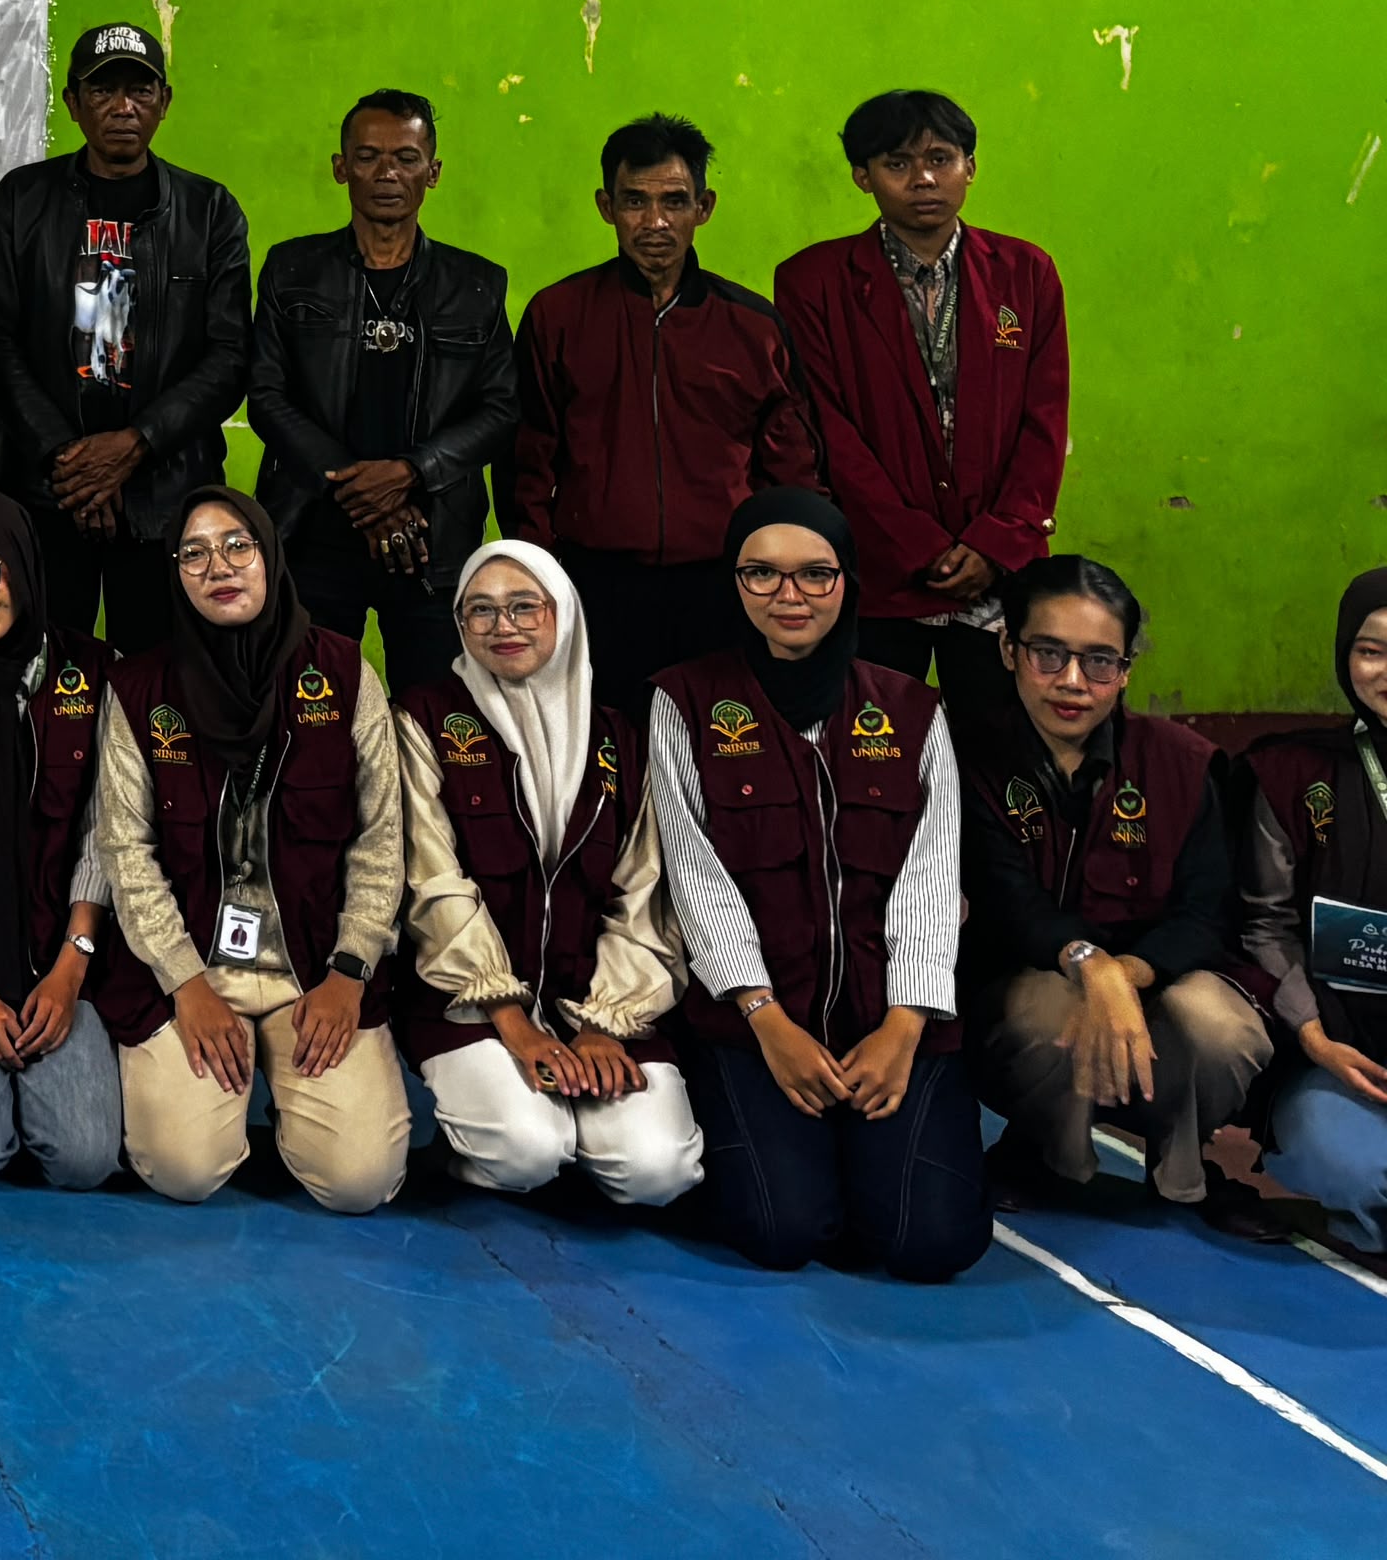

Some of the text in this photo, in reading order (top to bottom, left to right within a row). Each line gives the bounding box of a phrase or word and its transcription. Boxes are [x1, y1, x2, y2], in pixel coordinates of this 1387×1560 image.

[54, 705, 95, 716] UNINUS
[297, 710, 340, 724] UNINUS
[851, 746, 902, 758] UNINUS
